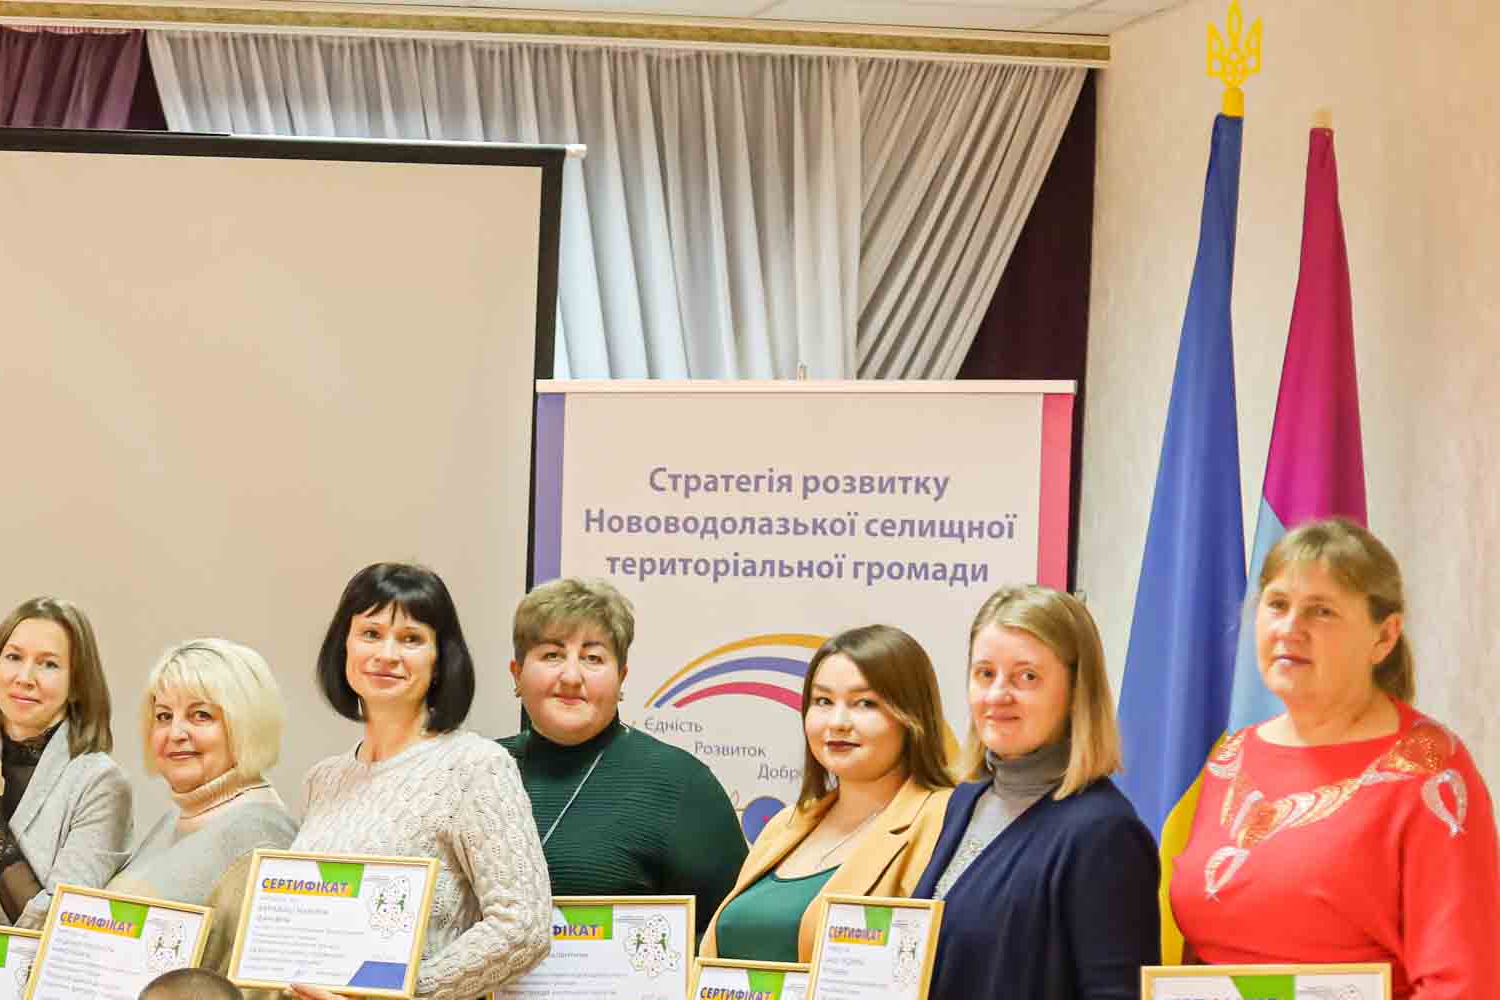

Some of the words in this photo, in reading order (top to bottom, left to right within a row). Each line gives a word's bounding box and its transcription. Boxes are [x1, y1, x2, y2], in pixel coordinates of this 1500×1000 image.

[648, 466, 793, 497] Стратегія
[801, 472, 950, 501] розвитку
[584, 507, 858, 542] Нововодолазької
[864, 511, 1019, 543] селищної
[605, 551, 846, 584] територіальної
[852, 558, 989, 587] громади
[644, 718, 704, 735] Єдність
[694, 741, 767, 759] Розвиток
[757, 763, 802, 781] Добр
[261, 877, 348, 894] СЕРТИФІКАТ
[60, 911, 132, 932] СЕРТИФІКАТ
